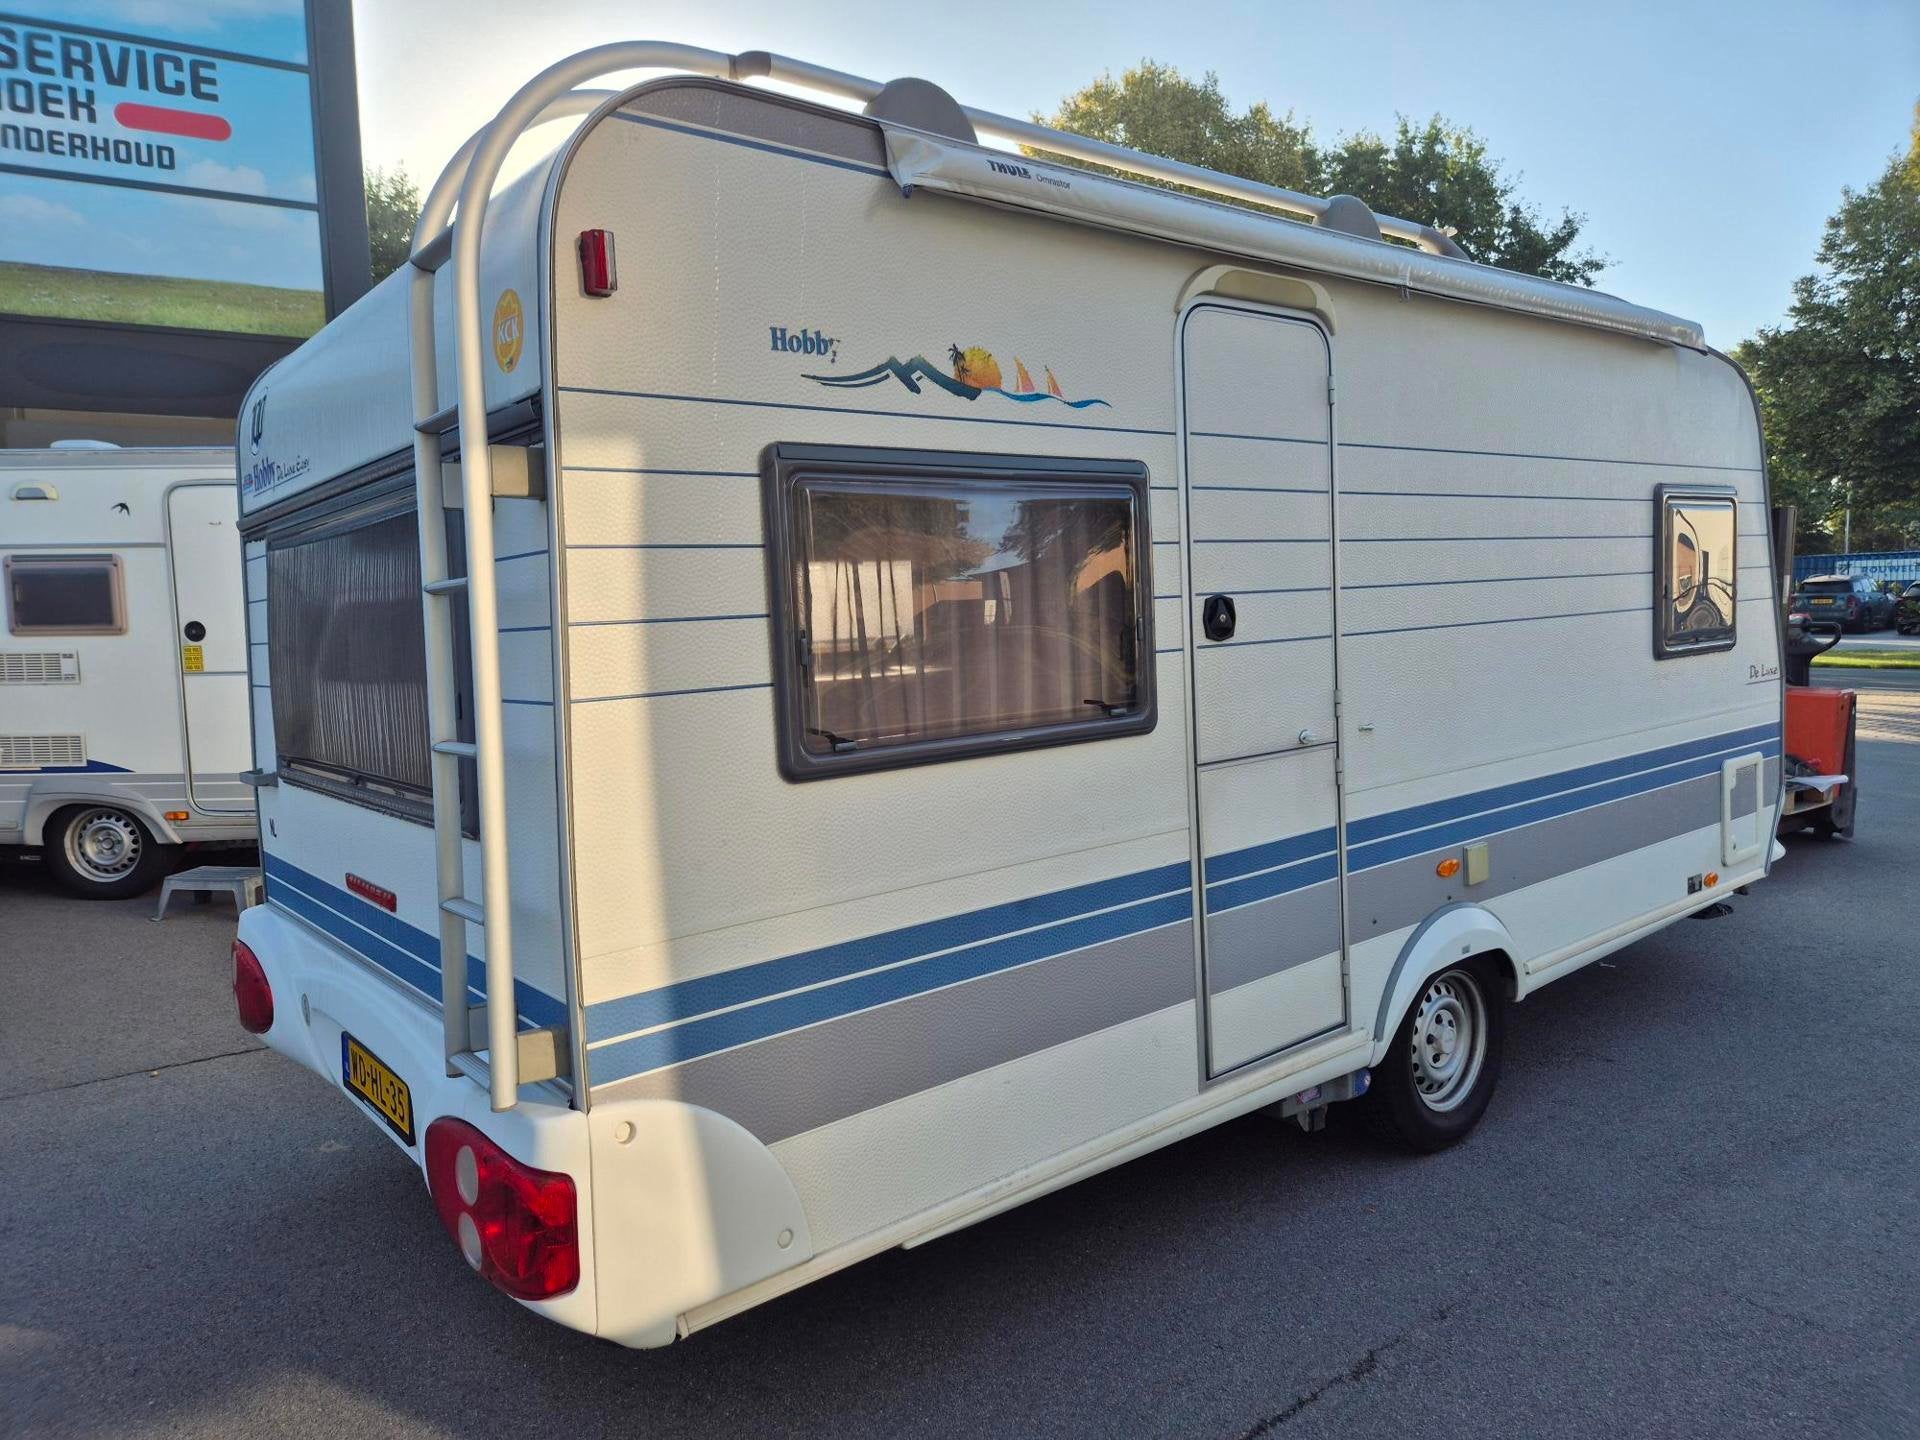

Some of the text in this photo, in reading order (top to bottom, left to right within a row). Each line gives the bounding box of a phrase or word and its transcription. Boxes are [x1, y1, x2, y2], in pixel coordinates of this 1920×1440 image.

[0, 26, 219, 103] SERVICE
[0, 77, 97, 124] OEK
[986, 159, 1031, 179] THULE
[253, 456, 275, 492] Hobby
[350, 1046, 405, 1123] WD-HL-35
